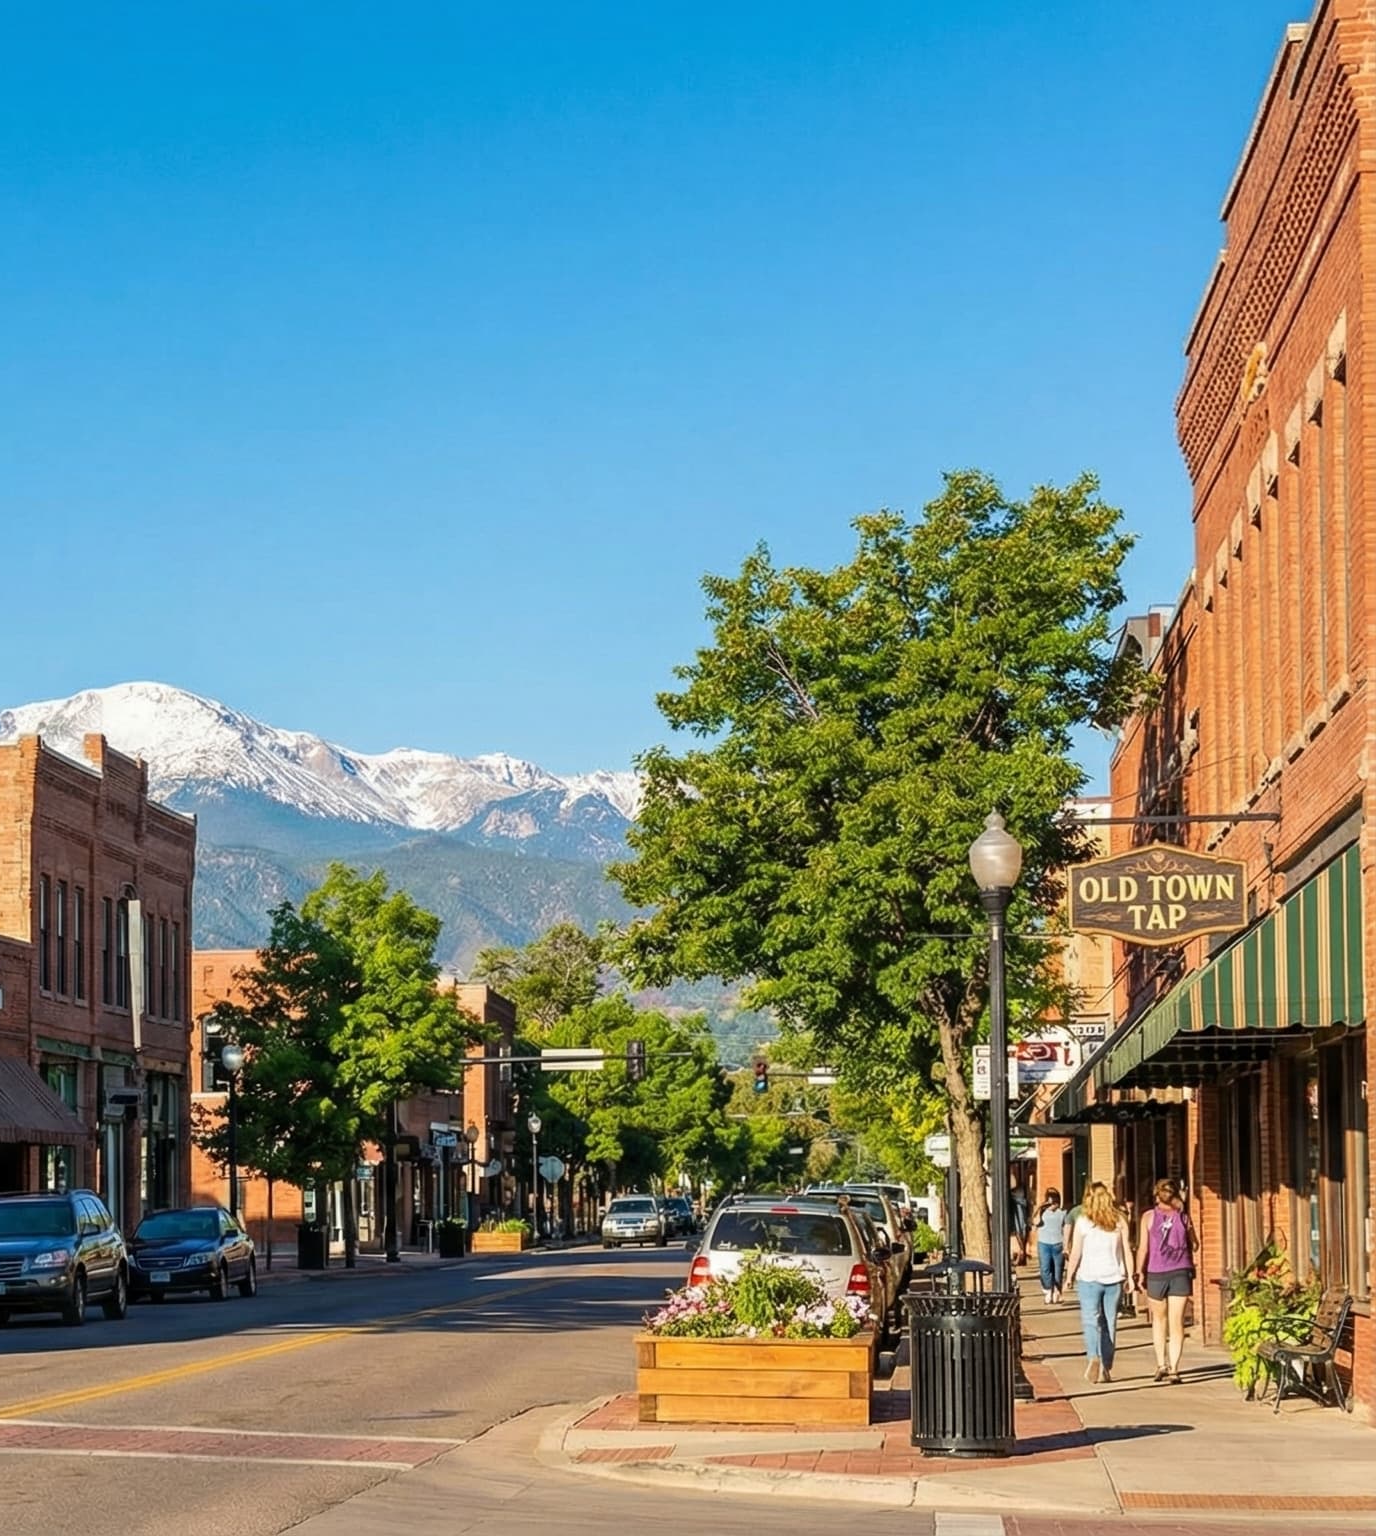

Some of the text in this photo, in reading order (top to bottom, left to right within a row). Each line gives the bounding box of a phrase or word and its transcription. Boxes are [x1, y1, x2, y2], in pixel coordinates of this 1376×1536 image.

[1079, 874, 1235, 902] OLD TOWN
[1127, 904, 1187, 930] TAP
